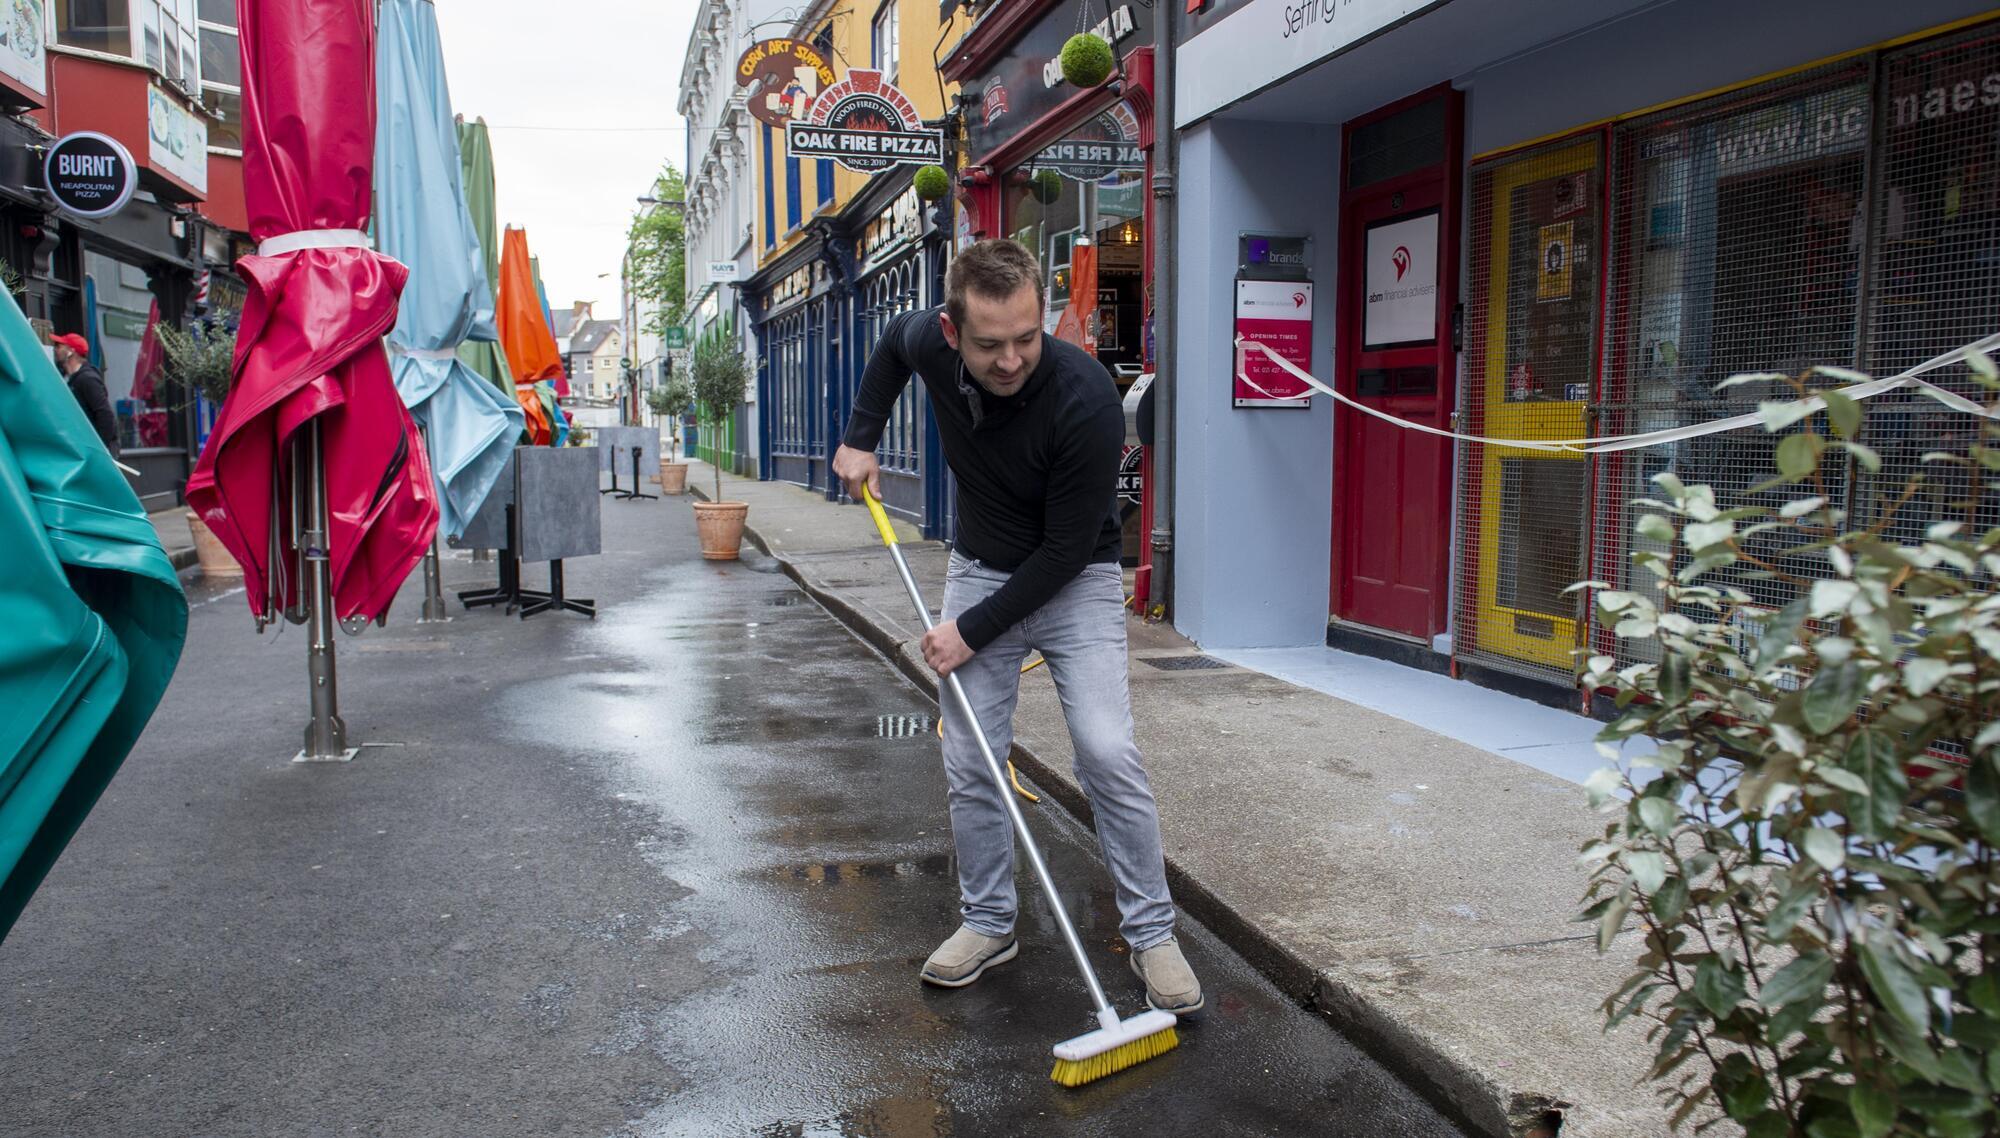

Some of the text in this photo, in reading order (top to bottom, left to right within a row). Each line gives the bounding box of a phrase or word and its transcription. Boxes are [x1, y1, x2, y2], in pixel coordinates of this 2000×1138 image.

[741, 40, 836, 86] CORK ART SUPPLIES
[834, 100, 895, 127] WOOD FIRED PIZZA
[794, 132, 938, 154] OAK FIRE PIZZA
[58, 154, 116, 177] BURNT
[870, 158, 887, 167] 2010
[60, 182, 115, 191] NEAPOLITAN
[1270, 251, 1304, 264] brands
[1368, 291, 1383, 303] abm
[1384, 287, 1408, 301] financial
